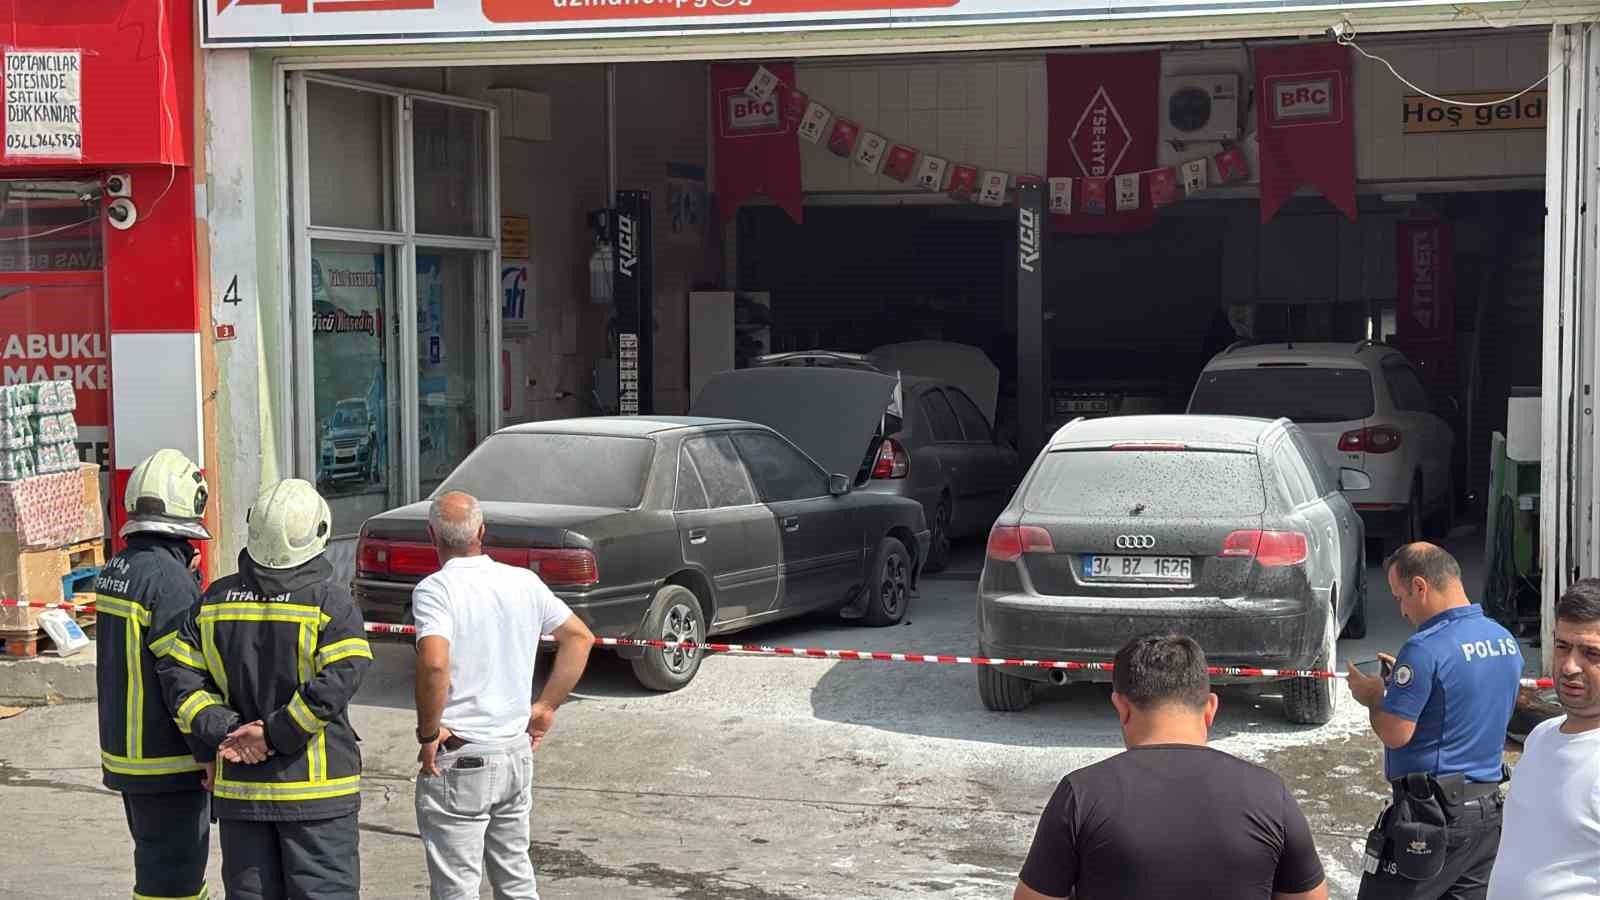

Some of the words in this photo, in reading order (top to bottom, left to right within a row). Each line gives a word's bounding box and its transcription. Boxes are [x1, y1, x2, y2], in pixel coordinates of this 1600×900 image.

[8, 90, 59, 103] SATILIK
[1280, 87, 1326, 107] BRC
[1402, 103, 1463, 127] Hoş
[1474, 97, 1542, 125] geld
[619, 214, 638, 277] RICO
[1020, 207, 1040, 272] RICO
[223, 274, 242, 306] 4
[0, 334, 107, 359] ABUKL
[1093, 558, 1112, 575] 34
[1121, 558, 1142, 576] BZ
[1154, 558, 1189, 577] 1626
